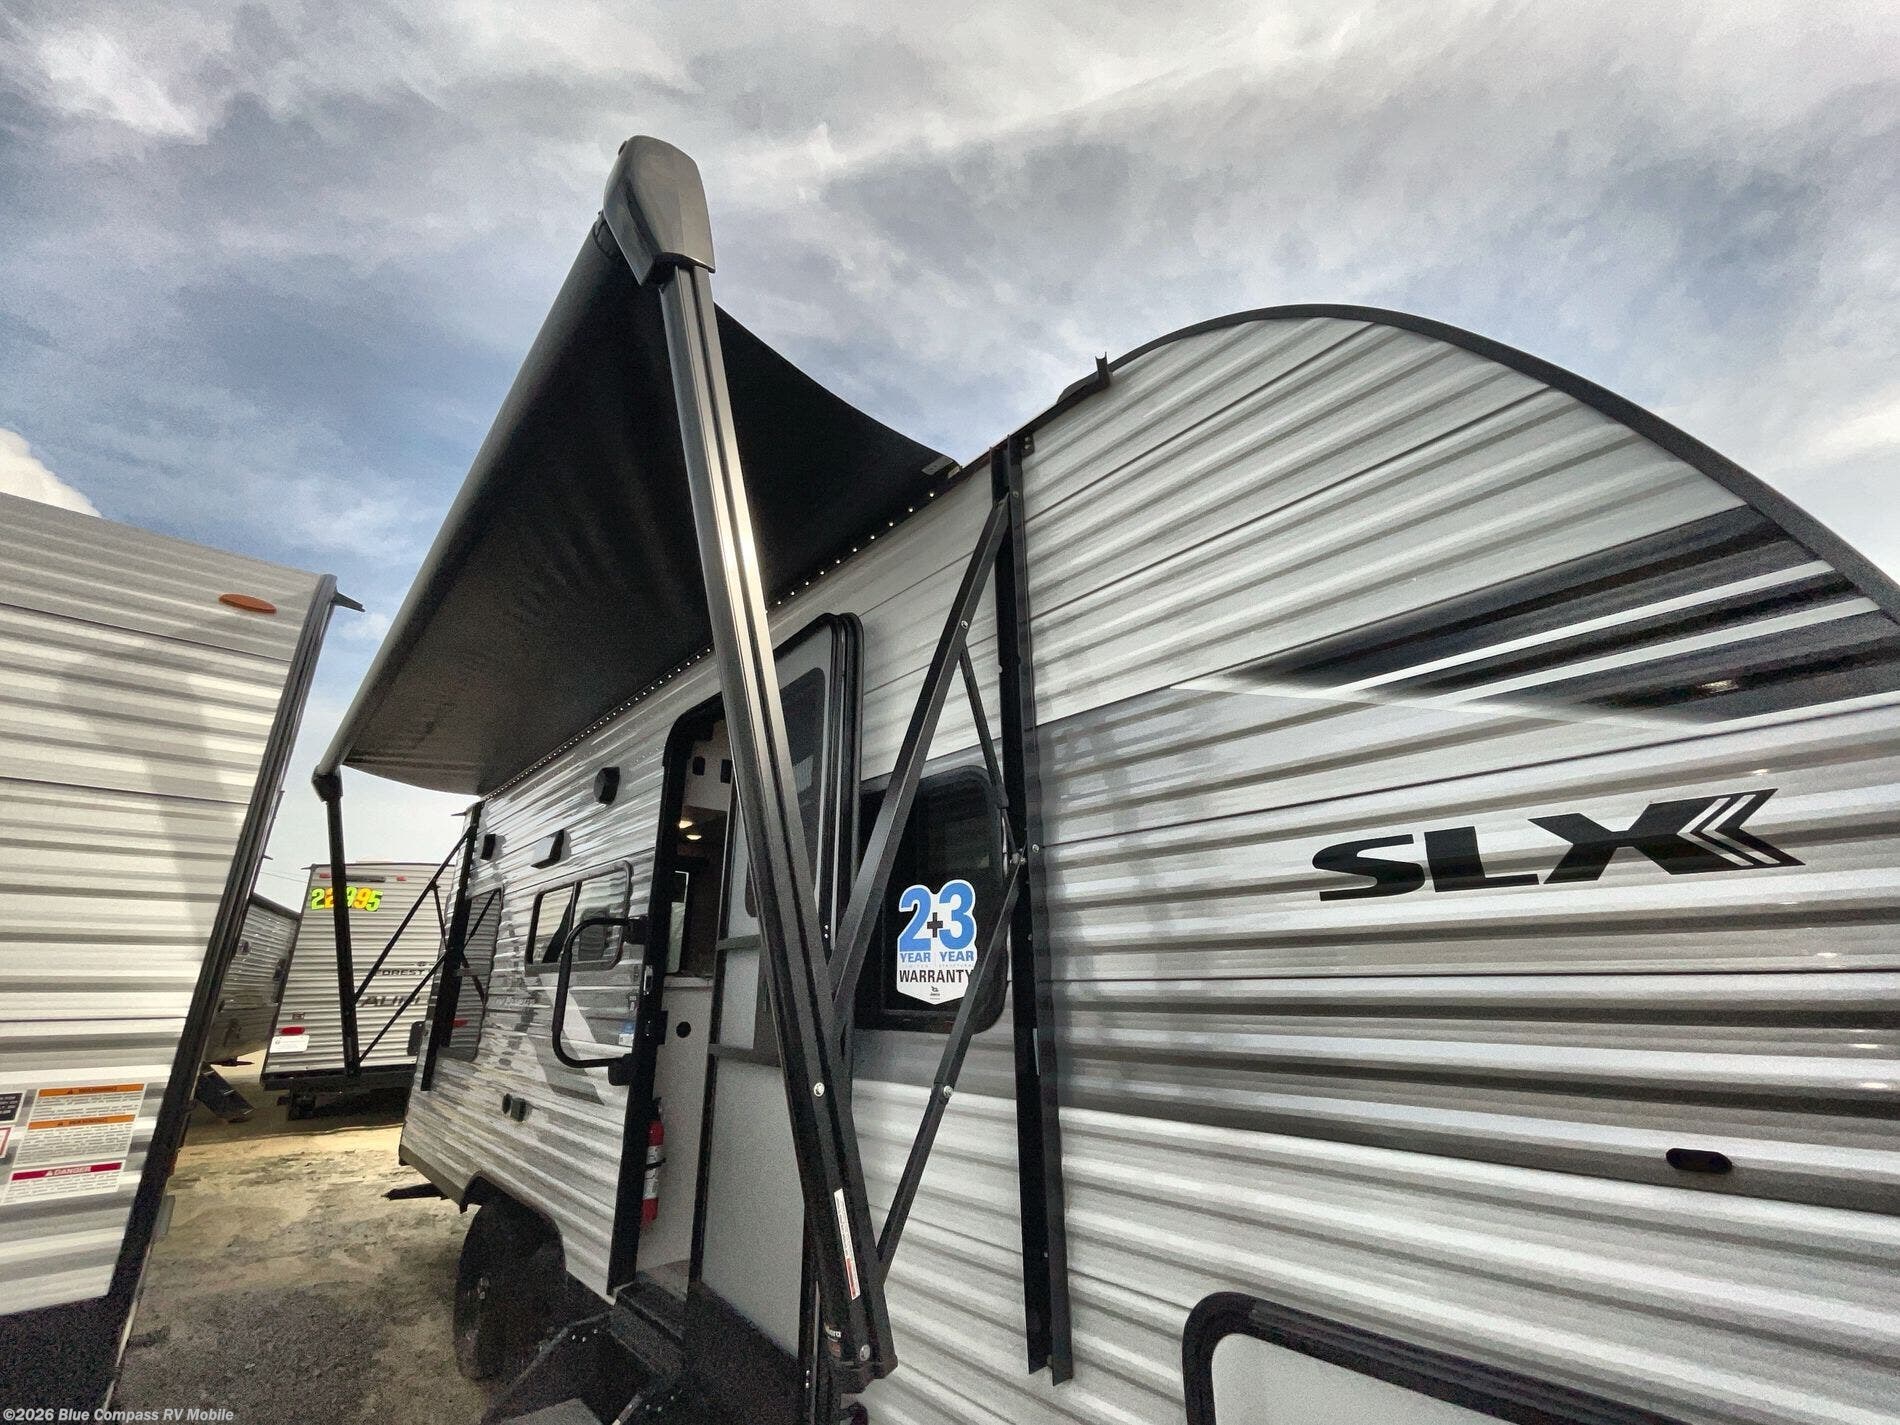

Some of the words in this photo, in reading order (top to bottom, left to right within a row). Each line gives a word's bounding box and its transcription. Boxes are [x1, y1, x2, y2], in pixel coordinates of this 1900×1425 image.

[1312, 788, 1806, 901] SLX
[900, 952, 931, 962] YEAR
[939, 951, 974, 962] YEAR
